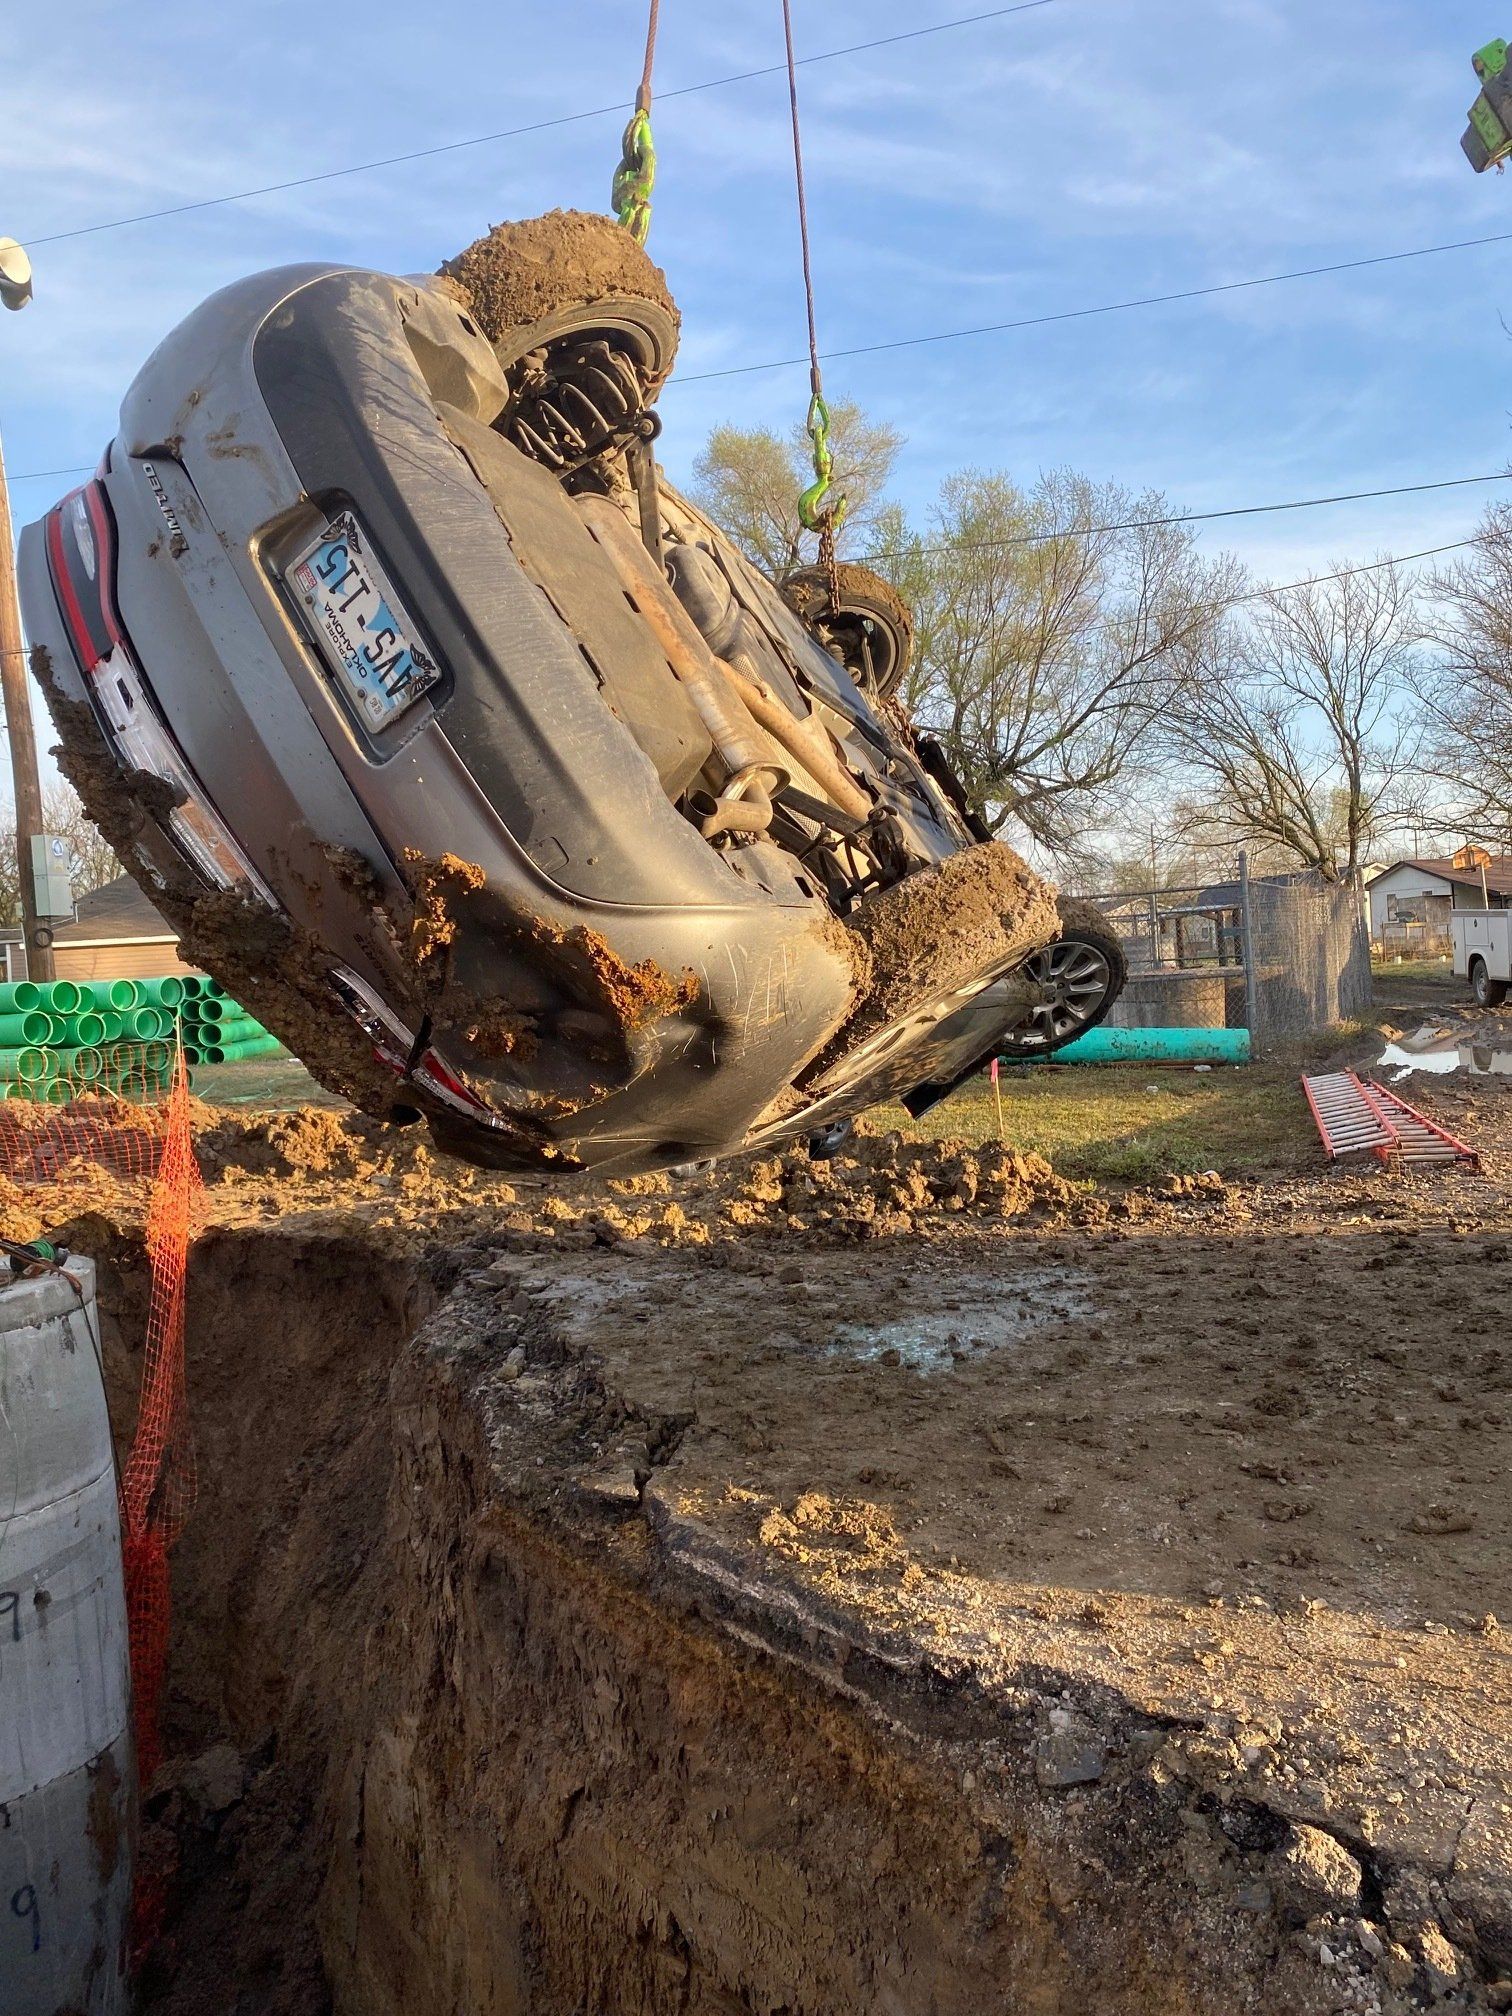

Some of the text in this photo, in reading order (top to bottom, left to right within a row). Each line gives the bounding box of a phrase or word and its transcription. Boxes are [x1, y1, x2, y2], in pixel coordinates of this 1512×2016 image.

[316, 544, 371, 613] 115
[324, 601, 367, 678] OKLAHOMA
[325, 621, 353, 668] EXPLORE
[362, 627, 413, 698] AVS
[0, 1591, 20, 1642] 9
[11, 1883, 40, 1952] 9
